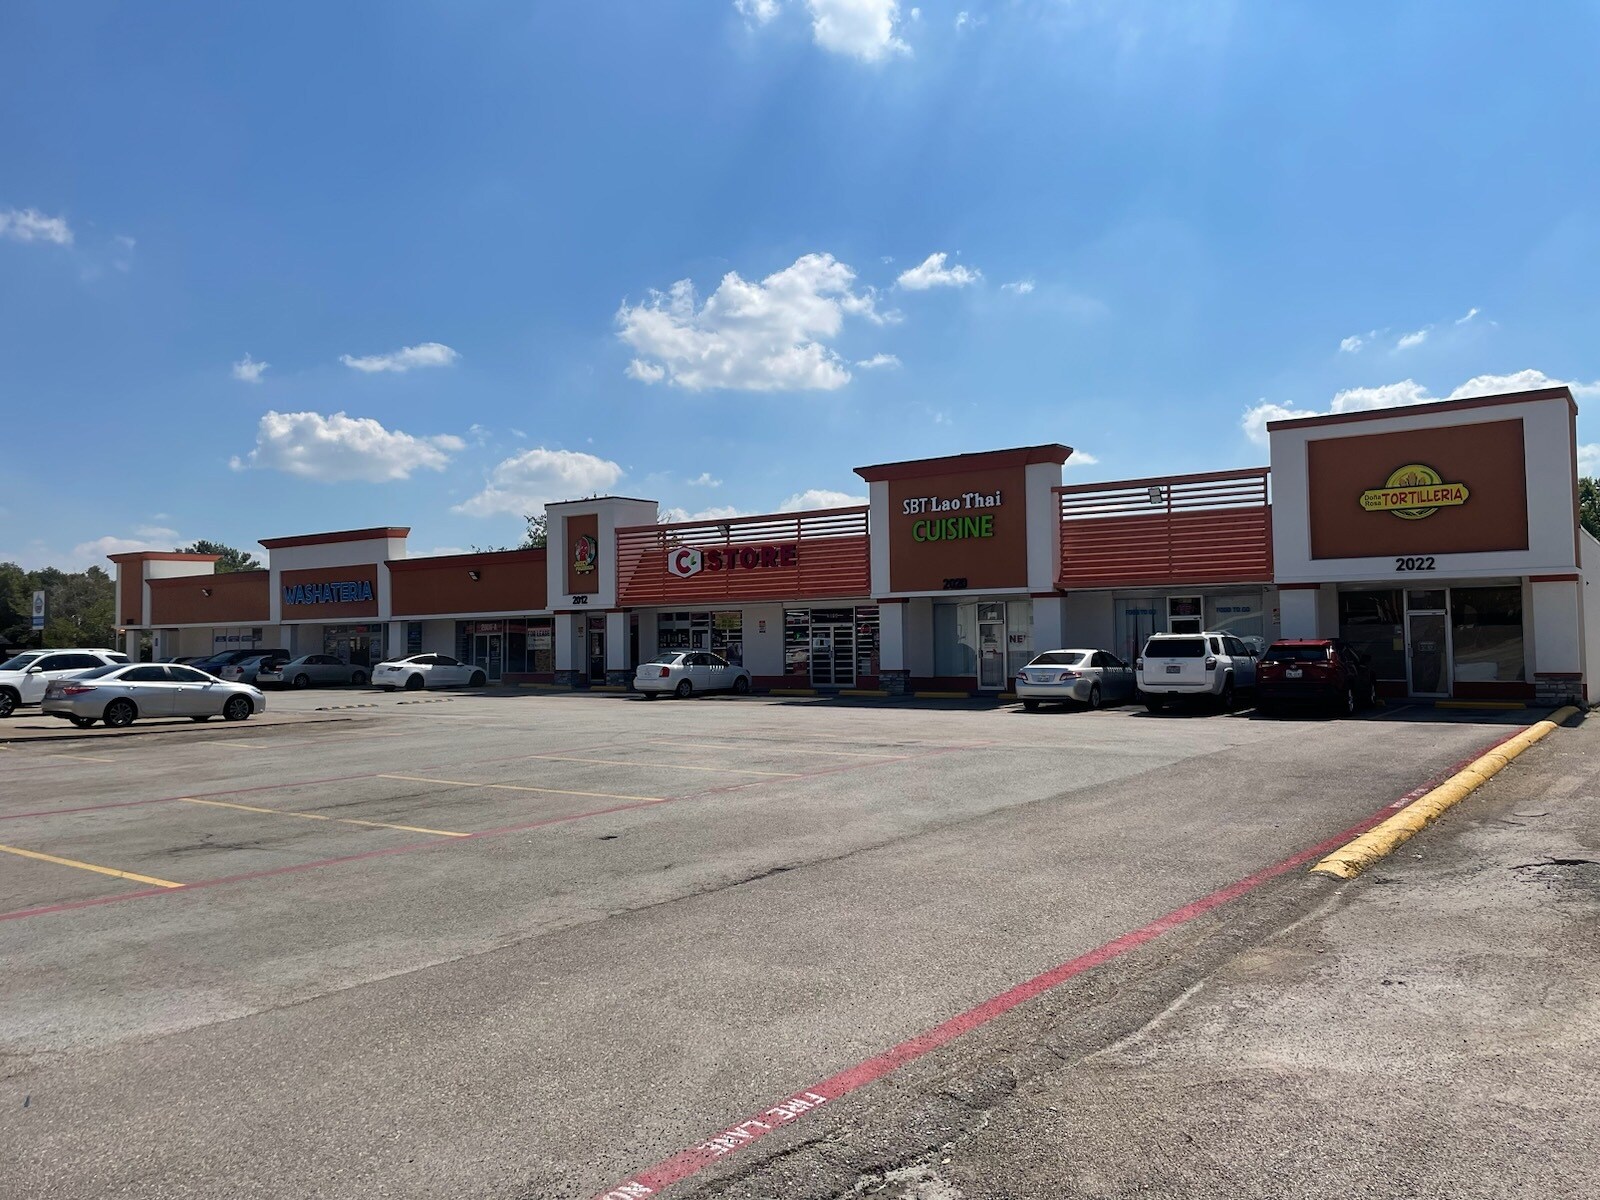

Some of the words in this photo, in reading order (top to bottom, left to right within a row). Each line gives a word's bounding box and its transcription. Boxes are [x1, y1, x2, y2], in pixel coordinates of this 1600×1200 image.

[902, 498, 928, 515] SBT
[930, 496, 961, 512] Lao
[962, 490, 1002, 509] Thai
[1382, 488, 1463, 506] TORTILLERIA
[912, 515, 994, 543] CUISINE
[708, 544, 796, 572] STORE
[1395, 556, 1436, 572] 2022
[283, 581, 375, 605] WASHATERIA
[572, 595, 588, 605] 2012
[537, 629, 550, 637] LEASE
[1009, 635, 1026, 643] NE
[765, 1091, 827, 1120] FIRE
[697, 1119, 772, 1156] LANE
